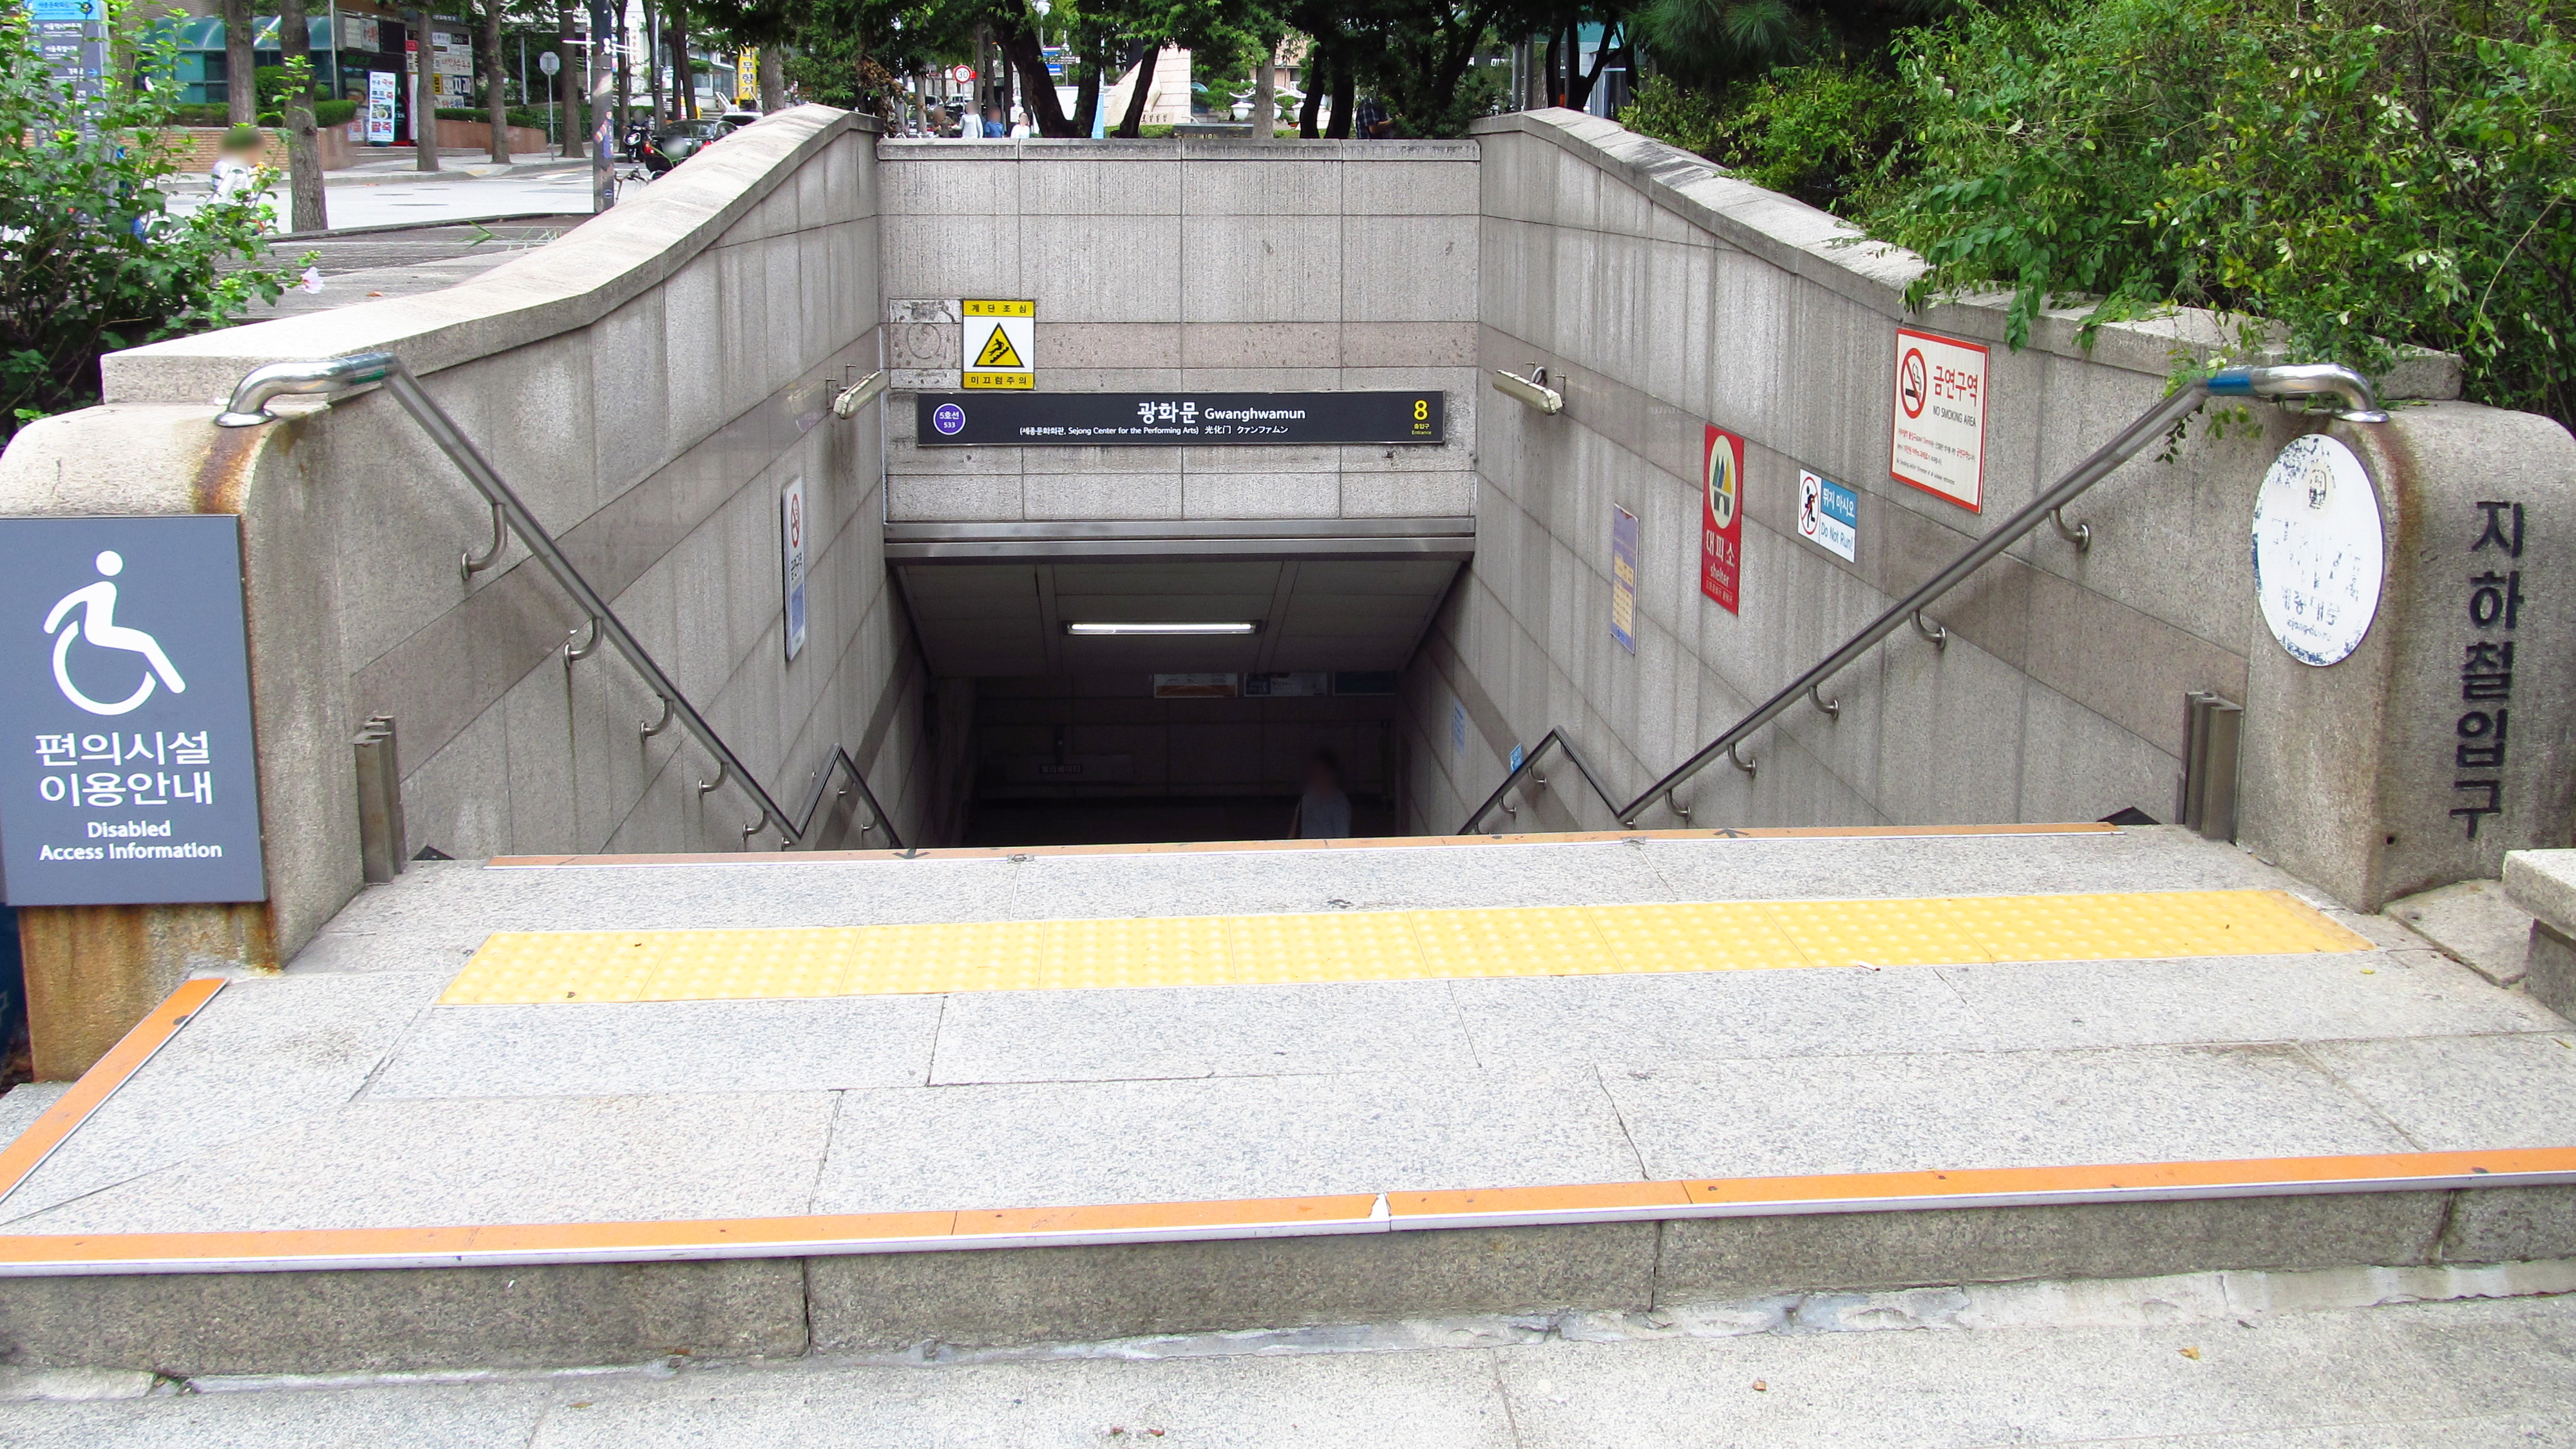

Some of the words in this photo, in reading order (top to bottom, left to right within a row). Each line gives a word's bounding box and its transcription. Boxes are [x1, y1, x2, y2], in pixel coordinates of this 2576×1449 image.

[958, 70, 969, 79] 30
[1933, 366, 1978, 407] 금연구역
[939, 411, 960, 420] 5호선
[1137, 401, 1200, 424] 광화문
[1204, 407, 1306, 422] Gwanghwamun
[1414, 400, 1428, 421] 8
[1933, 405, 1940, 416] NO
[1941, 407, 1963, 423] SMOKING
[1964, 414, 1976, 428] AREA
[1068, 427, 1092, 436] Sejong
[1143, 426, 1181, 436] Performing
[1182, 426, 1199, 435] Arts)
[1204, 425, 1232, 435] 光化门
[1823, 488, 1835, 510] 뛰지
[1836, 495, 1855, 518] 마시오
[1706, 529, 1735, 567] 대피소
[1821, 522, 1828, 538] Do
[1830, 526, 1839, 544] Not
[1841, 532, 1853, 552] Run!
[2449, 501, 2525, 841] 지하철입구
[35, 731, 211, 766] 편의시설
[39, 771, 213, 807] 이용안내
[86, 819, 171, 838] Disabled
[39, 844, 104, 860] Access
[108, 842, 223, 860] Information
